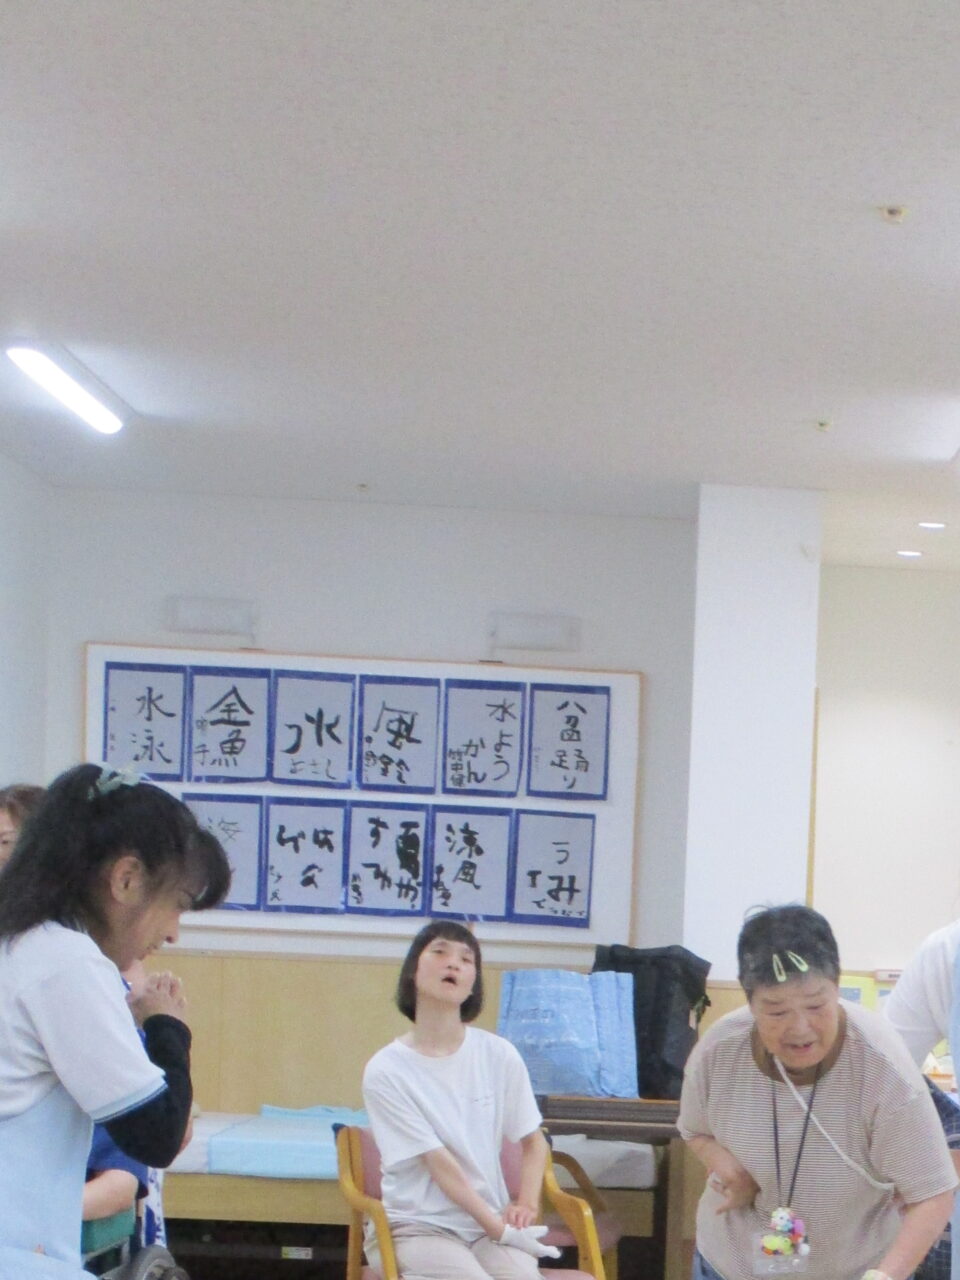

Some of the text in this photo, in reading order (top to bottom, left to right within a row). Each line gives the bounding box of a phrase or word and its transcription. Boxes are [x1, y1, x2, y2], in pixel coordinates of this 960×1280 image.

[130, 686, 177, 764] 水泳
[205, 685, 255, 767] 金魚
[462, 737, 487, 784] かん
[486, 698, 518, 781] 水よう
[550, 700, 590, 790] 盆踊り
[445, 821, 485, 890] 涼風
[547, 841, 581, 905] うみ
